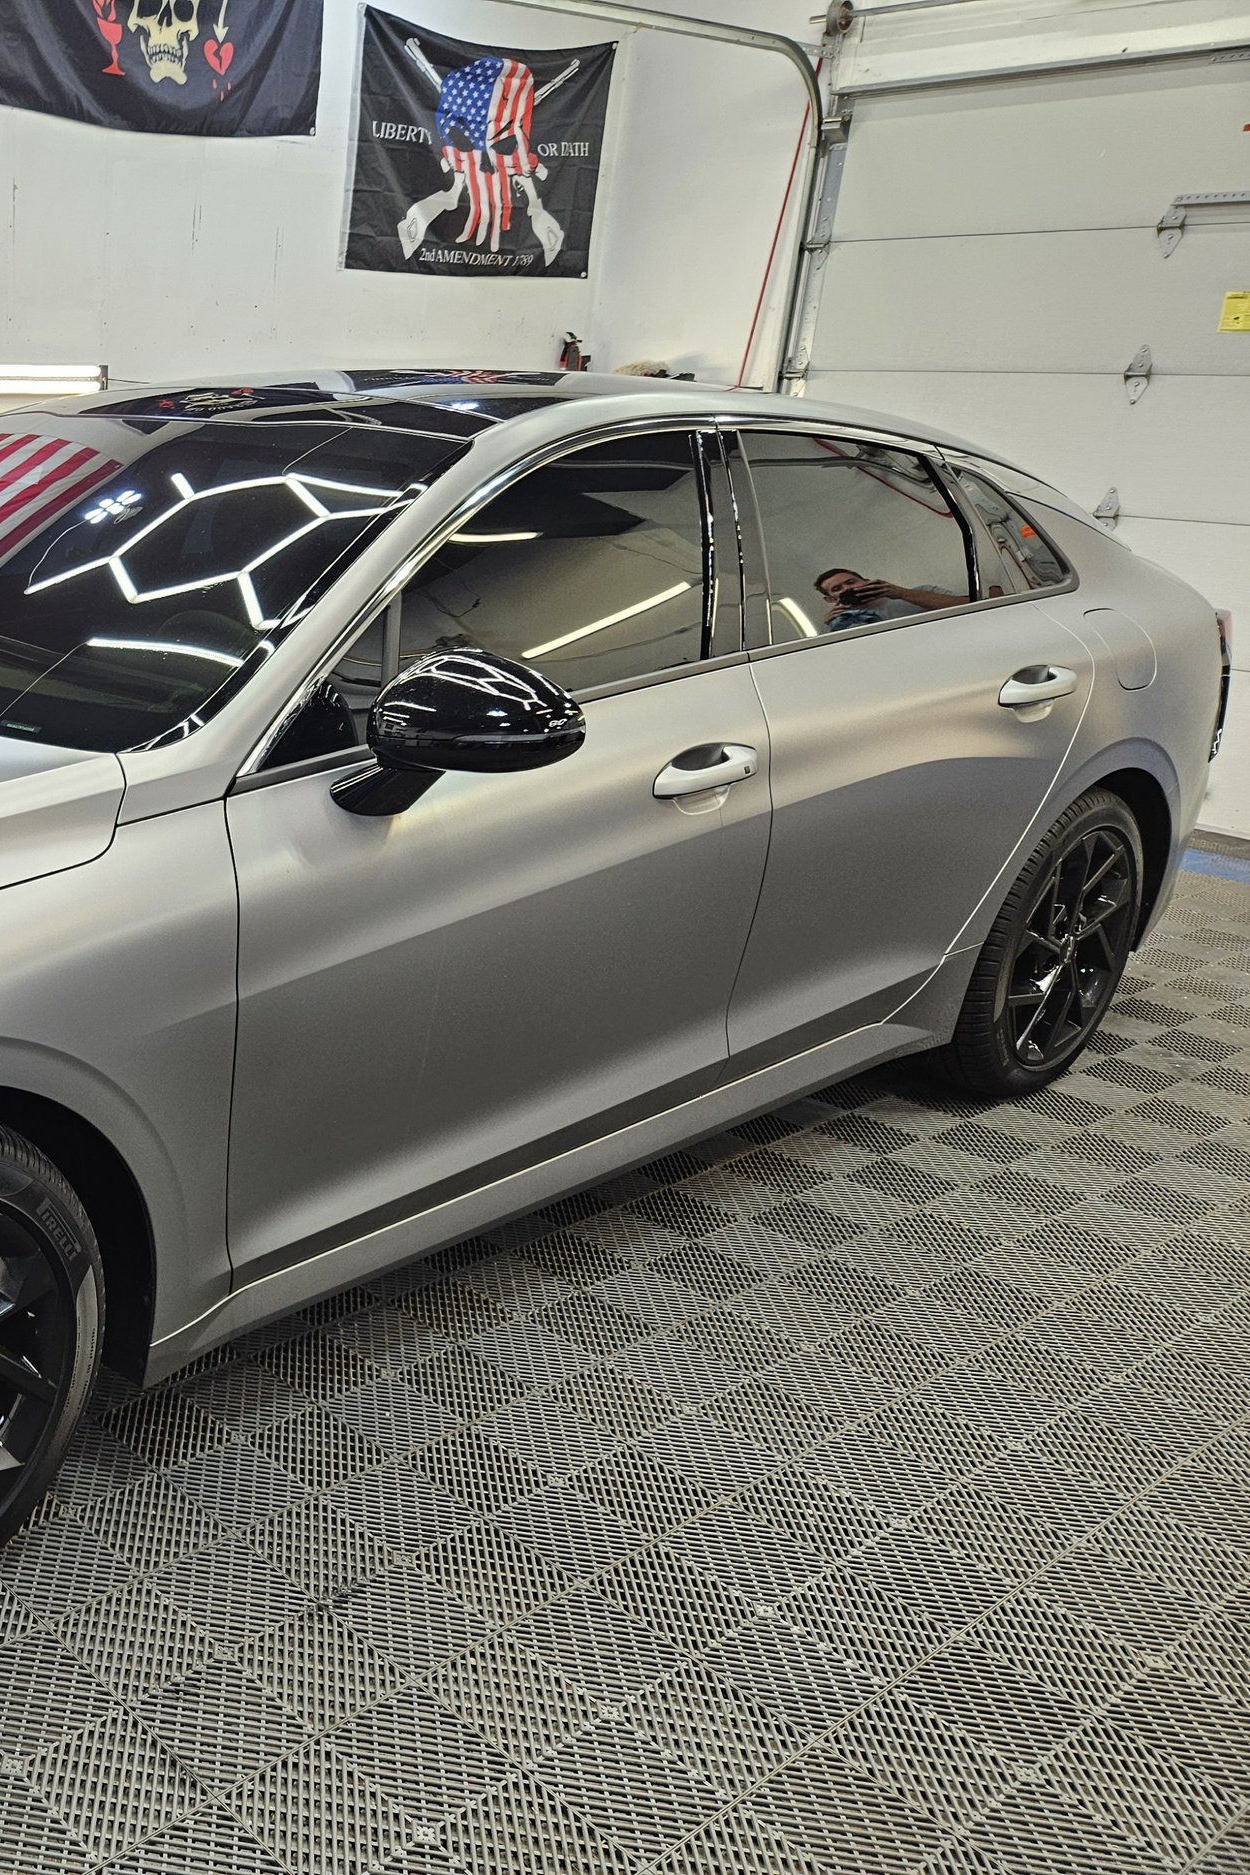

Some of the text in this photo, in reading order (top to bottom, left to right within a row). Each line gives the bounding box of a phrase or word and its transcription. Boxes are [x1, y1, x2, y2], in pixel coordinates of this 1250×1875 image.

[537, 143, 559, 157] OR
[419, 247, 436, 262] 2nd
[435, 249, 513, 267] AMENDMENT
[36, 1196, 82, 1261] PIRELLI
